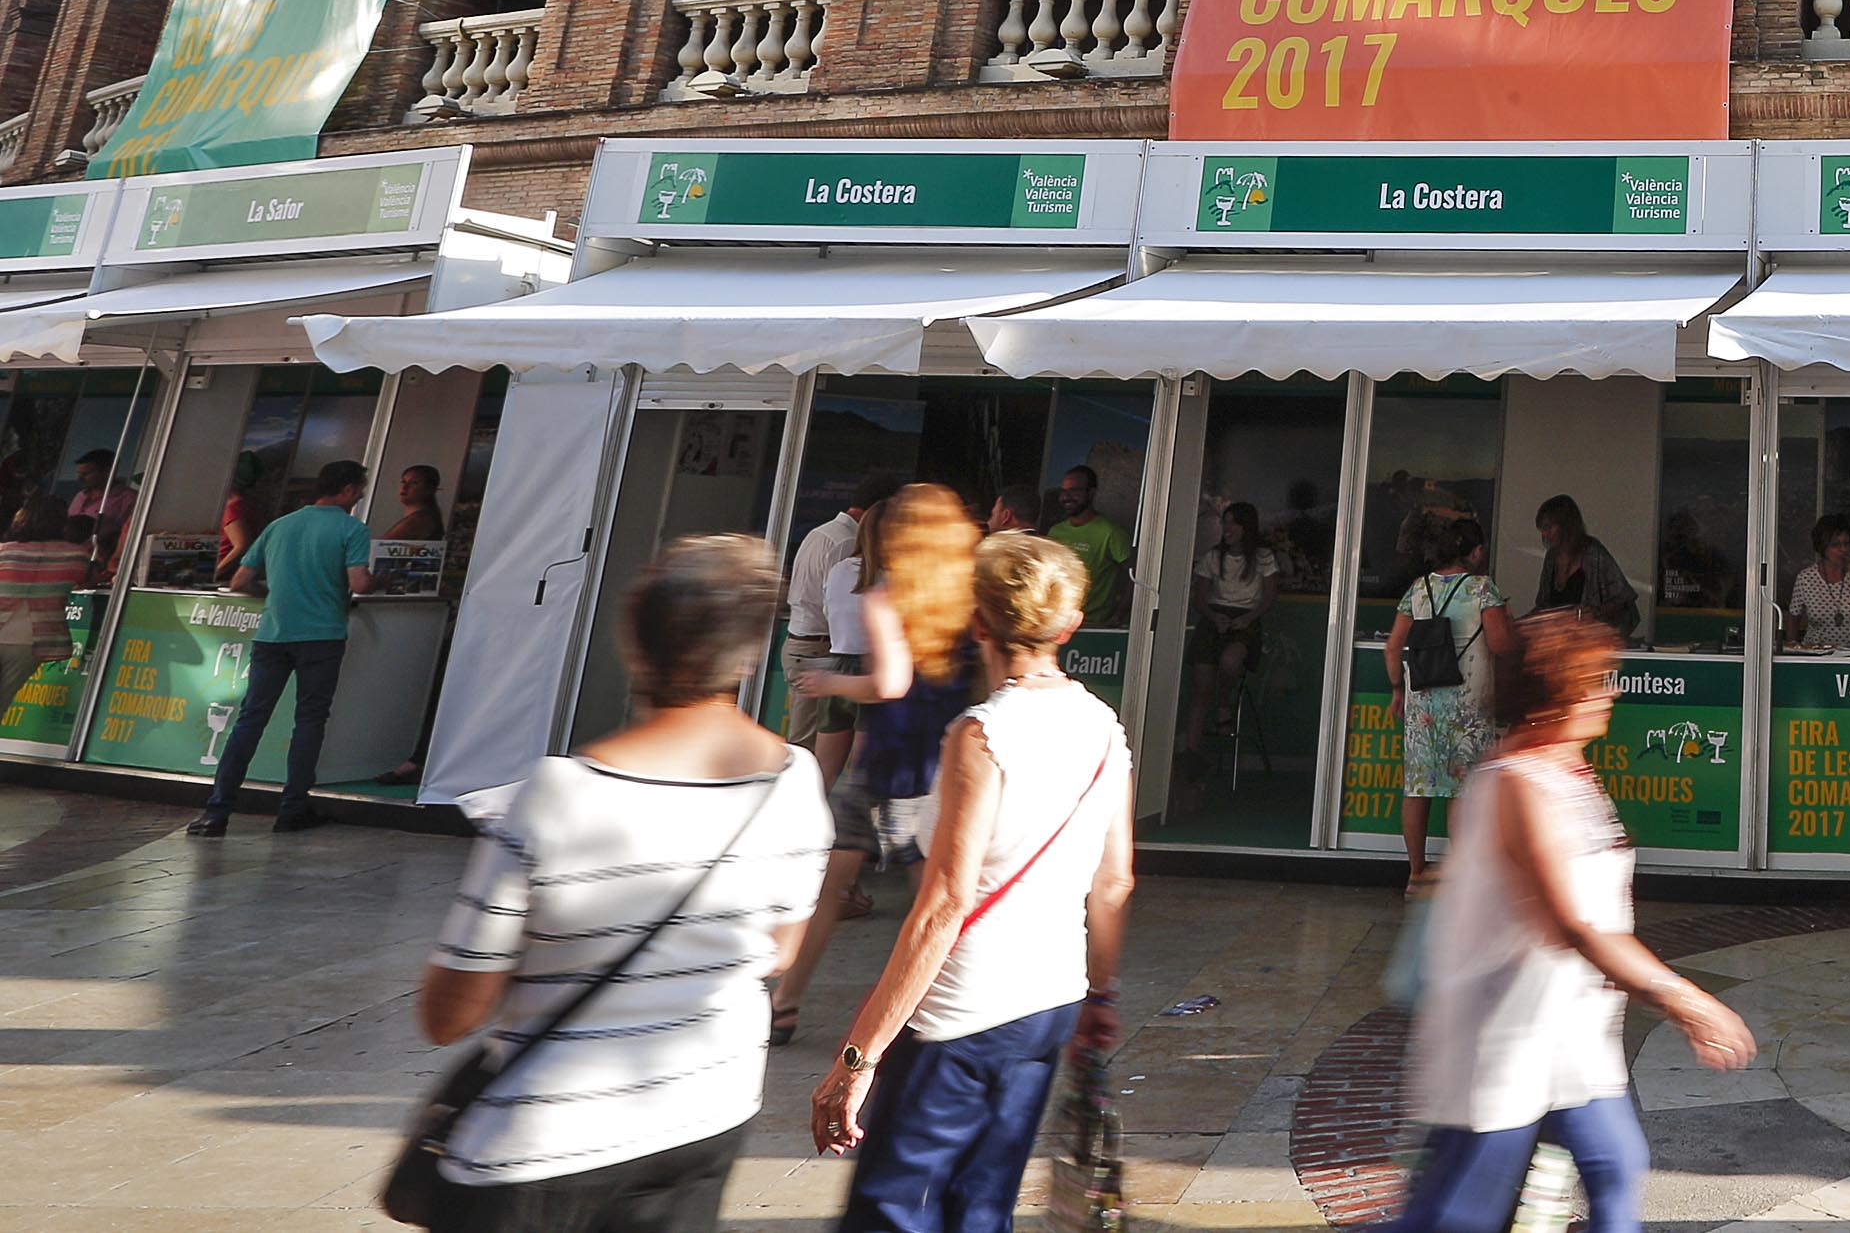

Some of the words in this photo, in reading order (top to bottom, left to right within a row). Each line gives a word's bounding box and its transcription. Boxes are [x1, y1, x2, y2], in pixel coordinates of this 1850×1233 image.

[1221, 32, 1398, 111] 2017
[805, 178, 831, 204] La
[834, 178, 916, 204] Costera
[1025, 188, 1072, 200] València
[1031, 175, 1077, 187] València
[1630, 179, 1683, 191] València
[1027, 201, 1073, 213] Turisme
[1378, 182, 1405, 209] La
[1413, 182, 1503, 210] Costera
[1625, 192, 1679, 205] València
[247, 200, 265, 223] La
[267, 197, 305, 221] Safor
[1629, 206, 1681, 219] Turisme
[189, 602, 206, 626] La
[122, 638, 153, 664] FIRA
[1065, 649, 1121, 675] Canal
[115, 663, 135, 688] DE
[134, 666, 159, 691] LES
[1603, 669, 1685, 695] Montesa
[108, 691, 188, 723] COMARQUES
[1350, 704, 1396, 730] FIRA
[101, 717, 136, 743] 2017
[1788, 719, 1840, 747] FIRA
[1346, 733, 1374, 759] DE
[1379, 733, 1403, 760] LE
[1592, 744, 1630, 770] LES
[1788, 749, 1817, 777] DE
[1343, 791, 1396, 819] 2017
[1788, 809, 1845, 837] 2017
